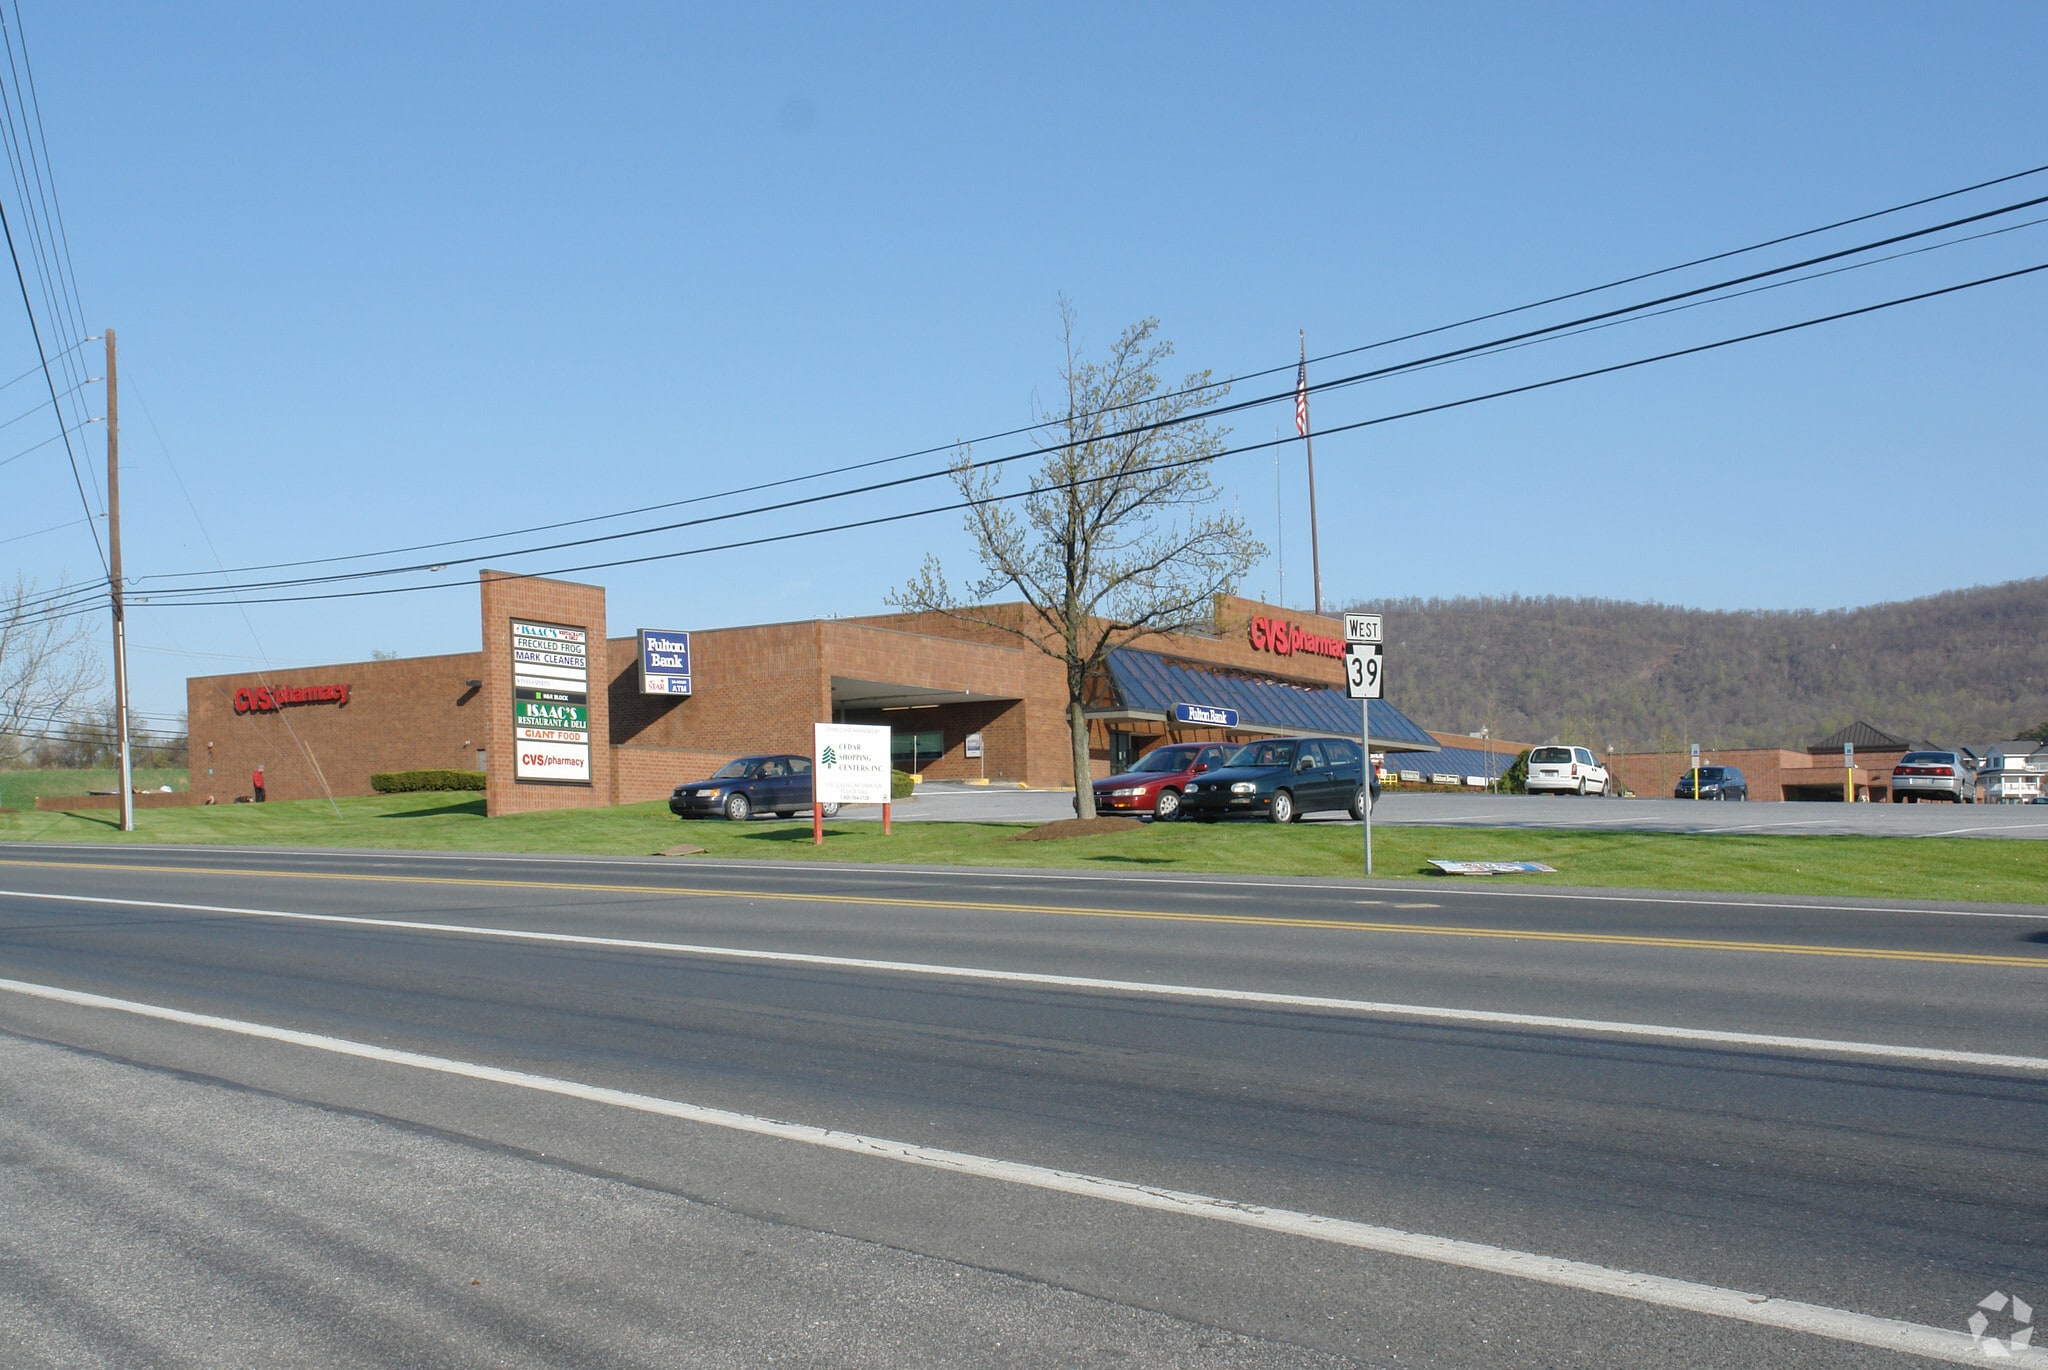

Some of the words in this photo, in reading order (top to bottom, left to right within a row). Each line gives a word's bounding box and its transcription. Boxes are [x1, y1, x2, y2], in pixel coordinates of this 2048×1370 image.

[521, 625, 557, 638] ISAAC'S
[1350, 619, 1378, 637] WEST
[1251, 615, 1346, 658] CVS/pharmac
[518, 638, 558, 651] FRECKLED
[561, 643, 582, 654] FROG
[647, 637, 686, 653] Fulton
[516, 651, 540, 662] MARK
[544, 654, 585, 667] CLEANERS
[651, 653, 683, 668] Bank
[1352, 657, 1378, 687] 39
[234, 684, 349, 711] CVS/pharmacy
[526, 704, 577, 720] ISAAC'S
[1189, 707, 1209, 721] Fulton
[1210, 710, 1227, 724] Bank
[518, 716, 562, 727] RESTAURANT
[571, 721, 587, 729] DELI
[525, 730, 554, 739] GIANT
[558, 732, 580, 740] FOOD
[523, 754, 584, 767] CVS/pharmacy
